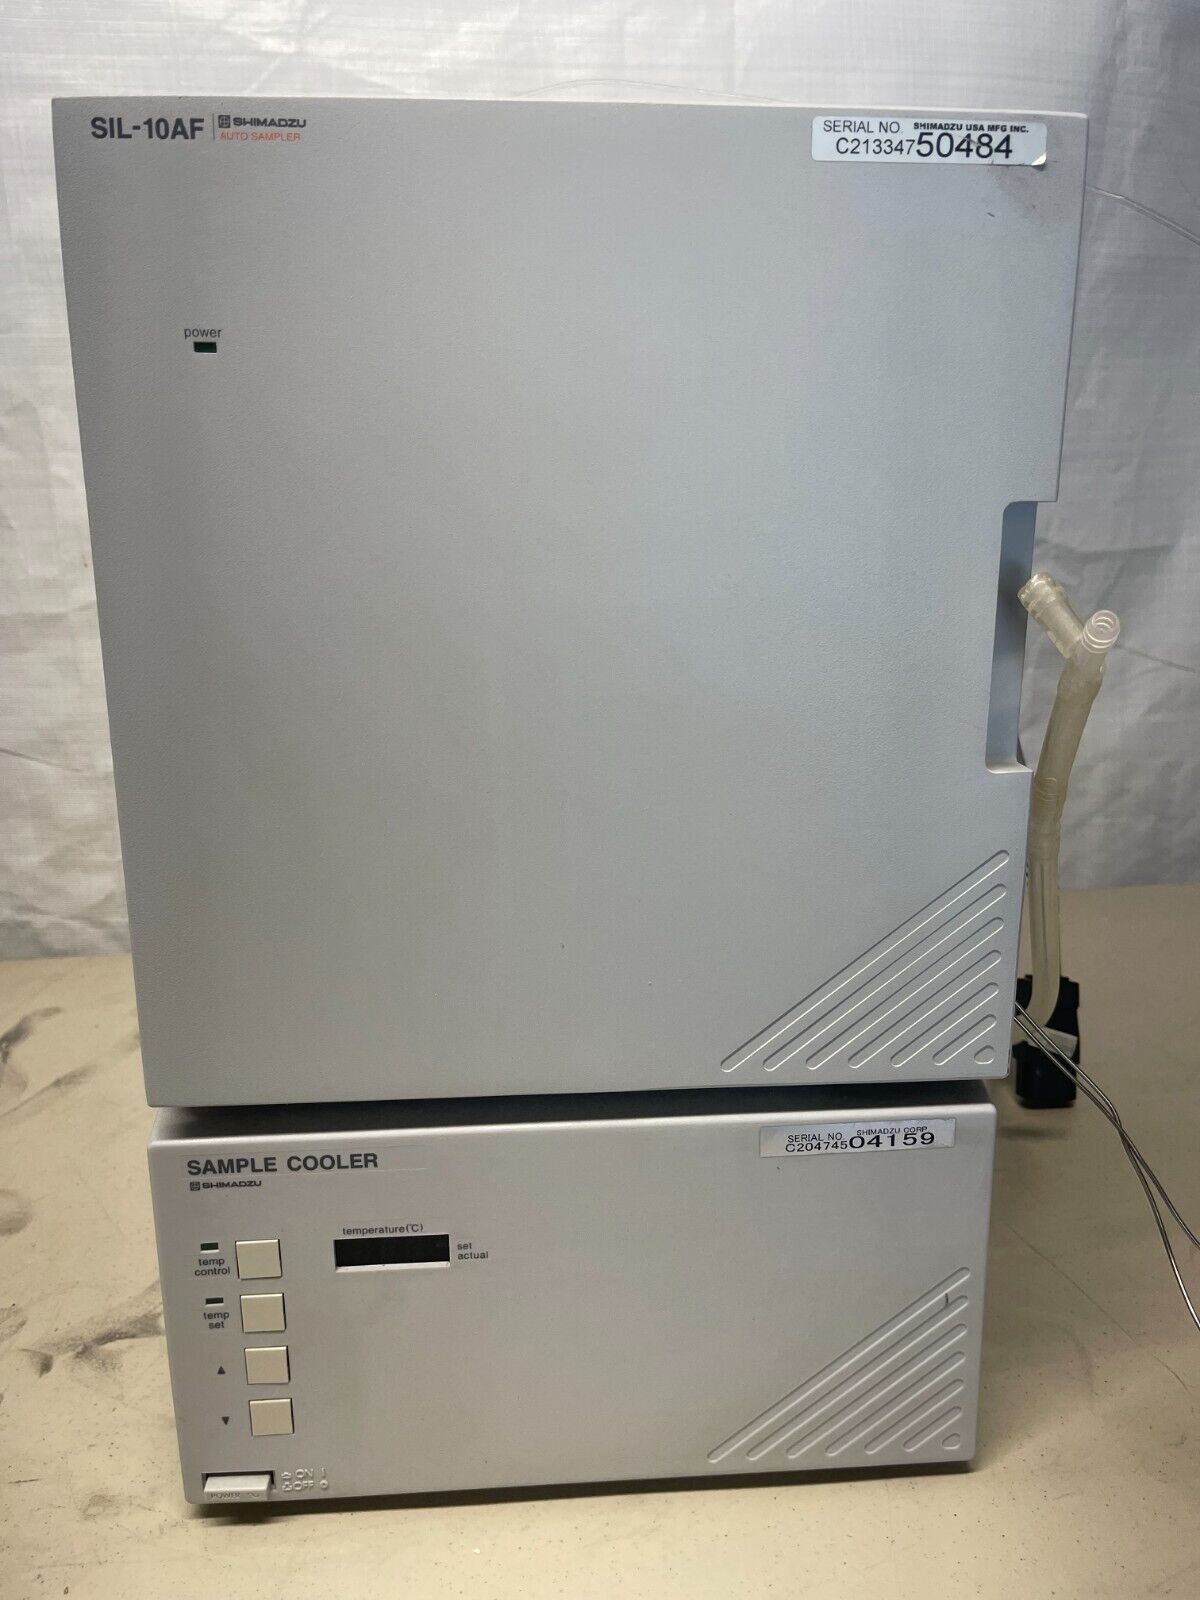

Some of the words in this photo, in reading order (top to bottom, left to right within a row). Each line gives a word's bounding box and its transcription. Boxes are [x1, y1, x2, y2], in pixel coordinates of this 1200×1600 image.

[233, 117, 307, 128] SHIMADZU
[823, 119, 874, 133] SERIAL
[913, 122, 963, 131] SHIMADZU
[966, 123, 985, 132] USA
[987, 124, 1007, 132] MFG
[1009, 125, 1029, 133] INC.
[91, 116, 204, 140] SIL-10AF
[219, 131, 248, 141] AUTO
[251, 131, 301, 141] SAMPLER
[184, 328, 222, 340] power
[856, 1128, 901, 1136] SHIMADZU
[787, 1133, 823, 1143] SERIAL
[187, 1157, 278, 1176] SAMPLE
[287, 1152, 378, 1172] COOLER
[202, 1180, 262, 1189] SHIMADZU
[457, 1242, 472, 1250] set
[457, 1251, 489, 1260] actual
[198, 1258, 225, 1266] temp
[194, 1266, 230, 1276] control
[203, 1312, 230, 1320] temp
[208, 1321, 225, 1330] set
